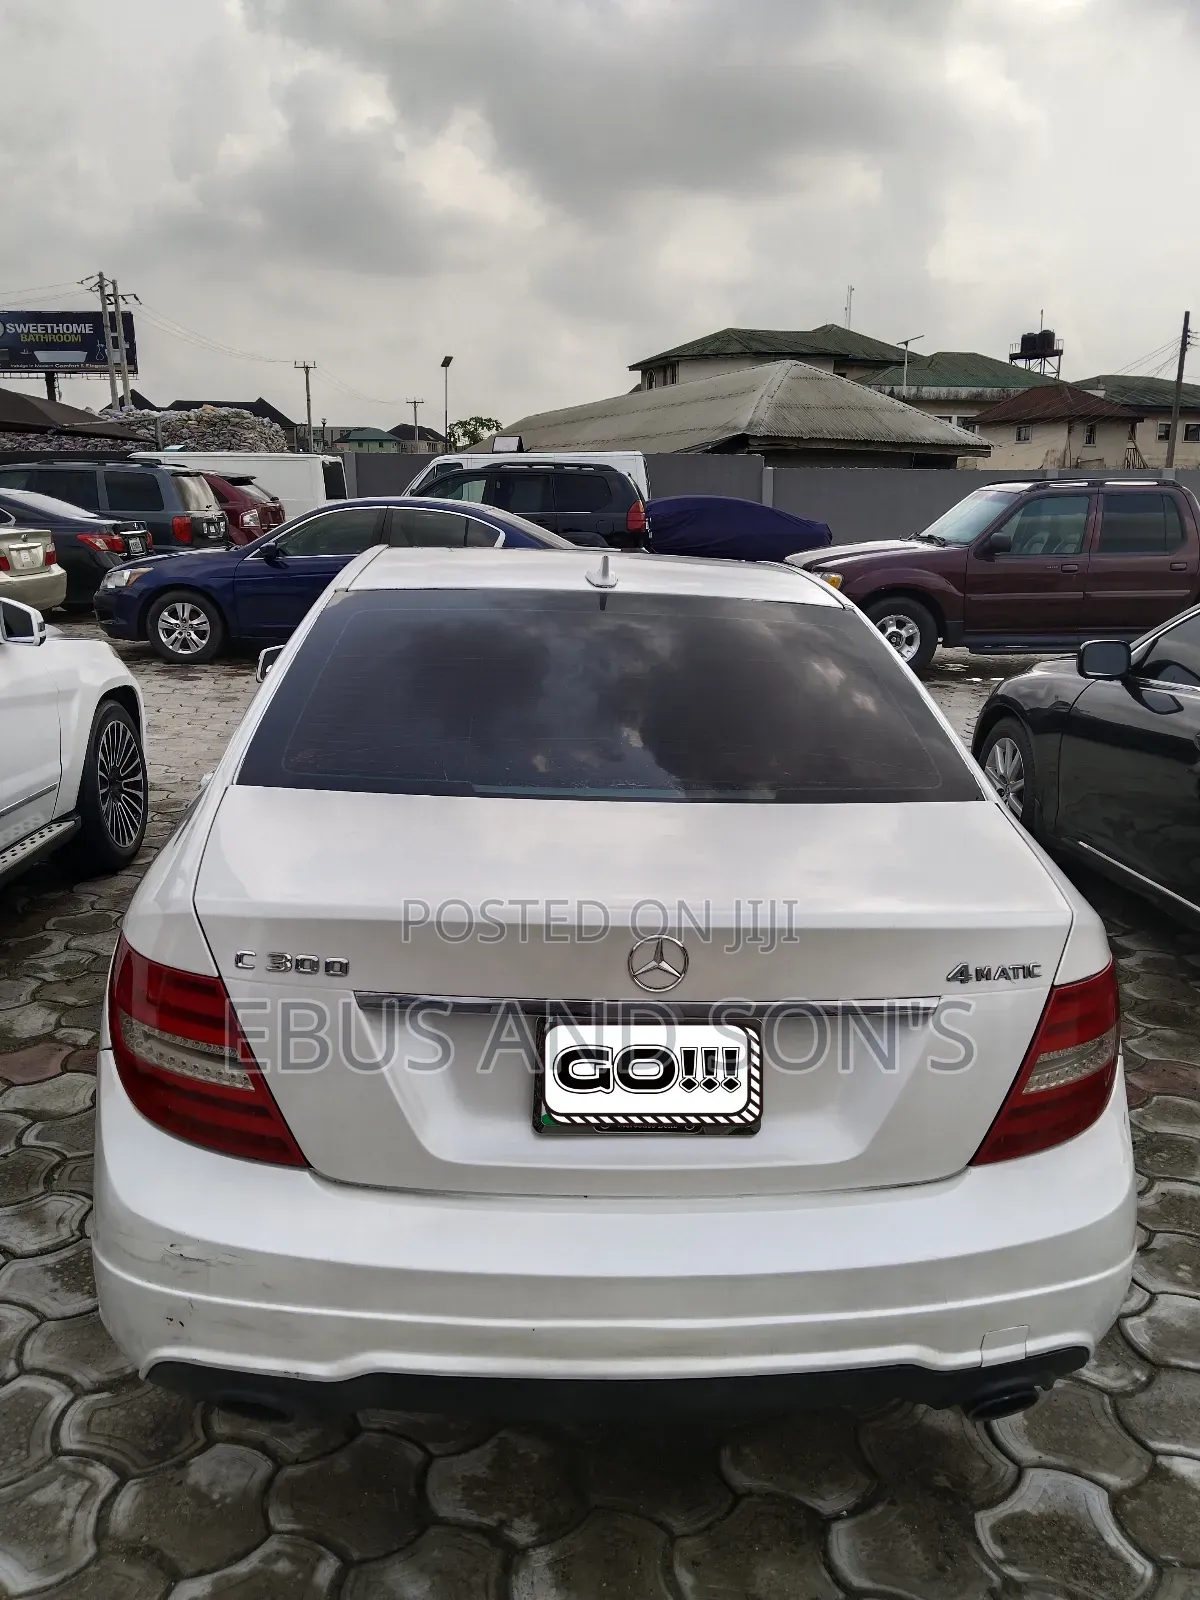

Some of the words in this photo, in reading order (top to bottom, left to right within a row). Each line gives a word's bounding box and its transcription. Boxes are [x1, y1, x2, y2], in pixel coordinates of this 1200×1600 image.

[5, 323, 94, 334] SWEETHOME
[20, 333, 82, 342] BATHROOM
[234, 949, 257, 970] C
[265, 951, 350, 977] 300
